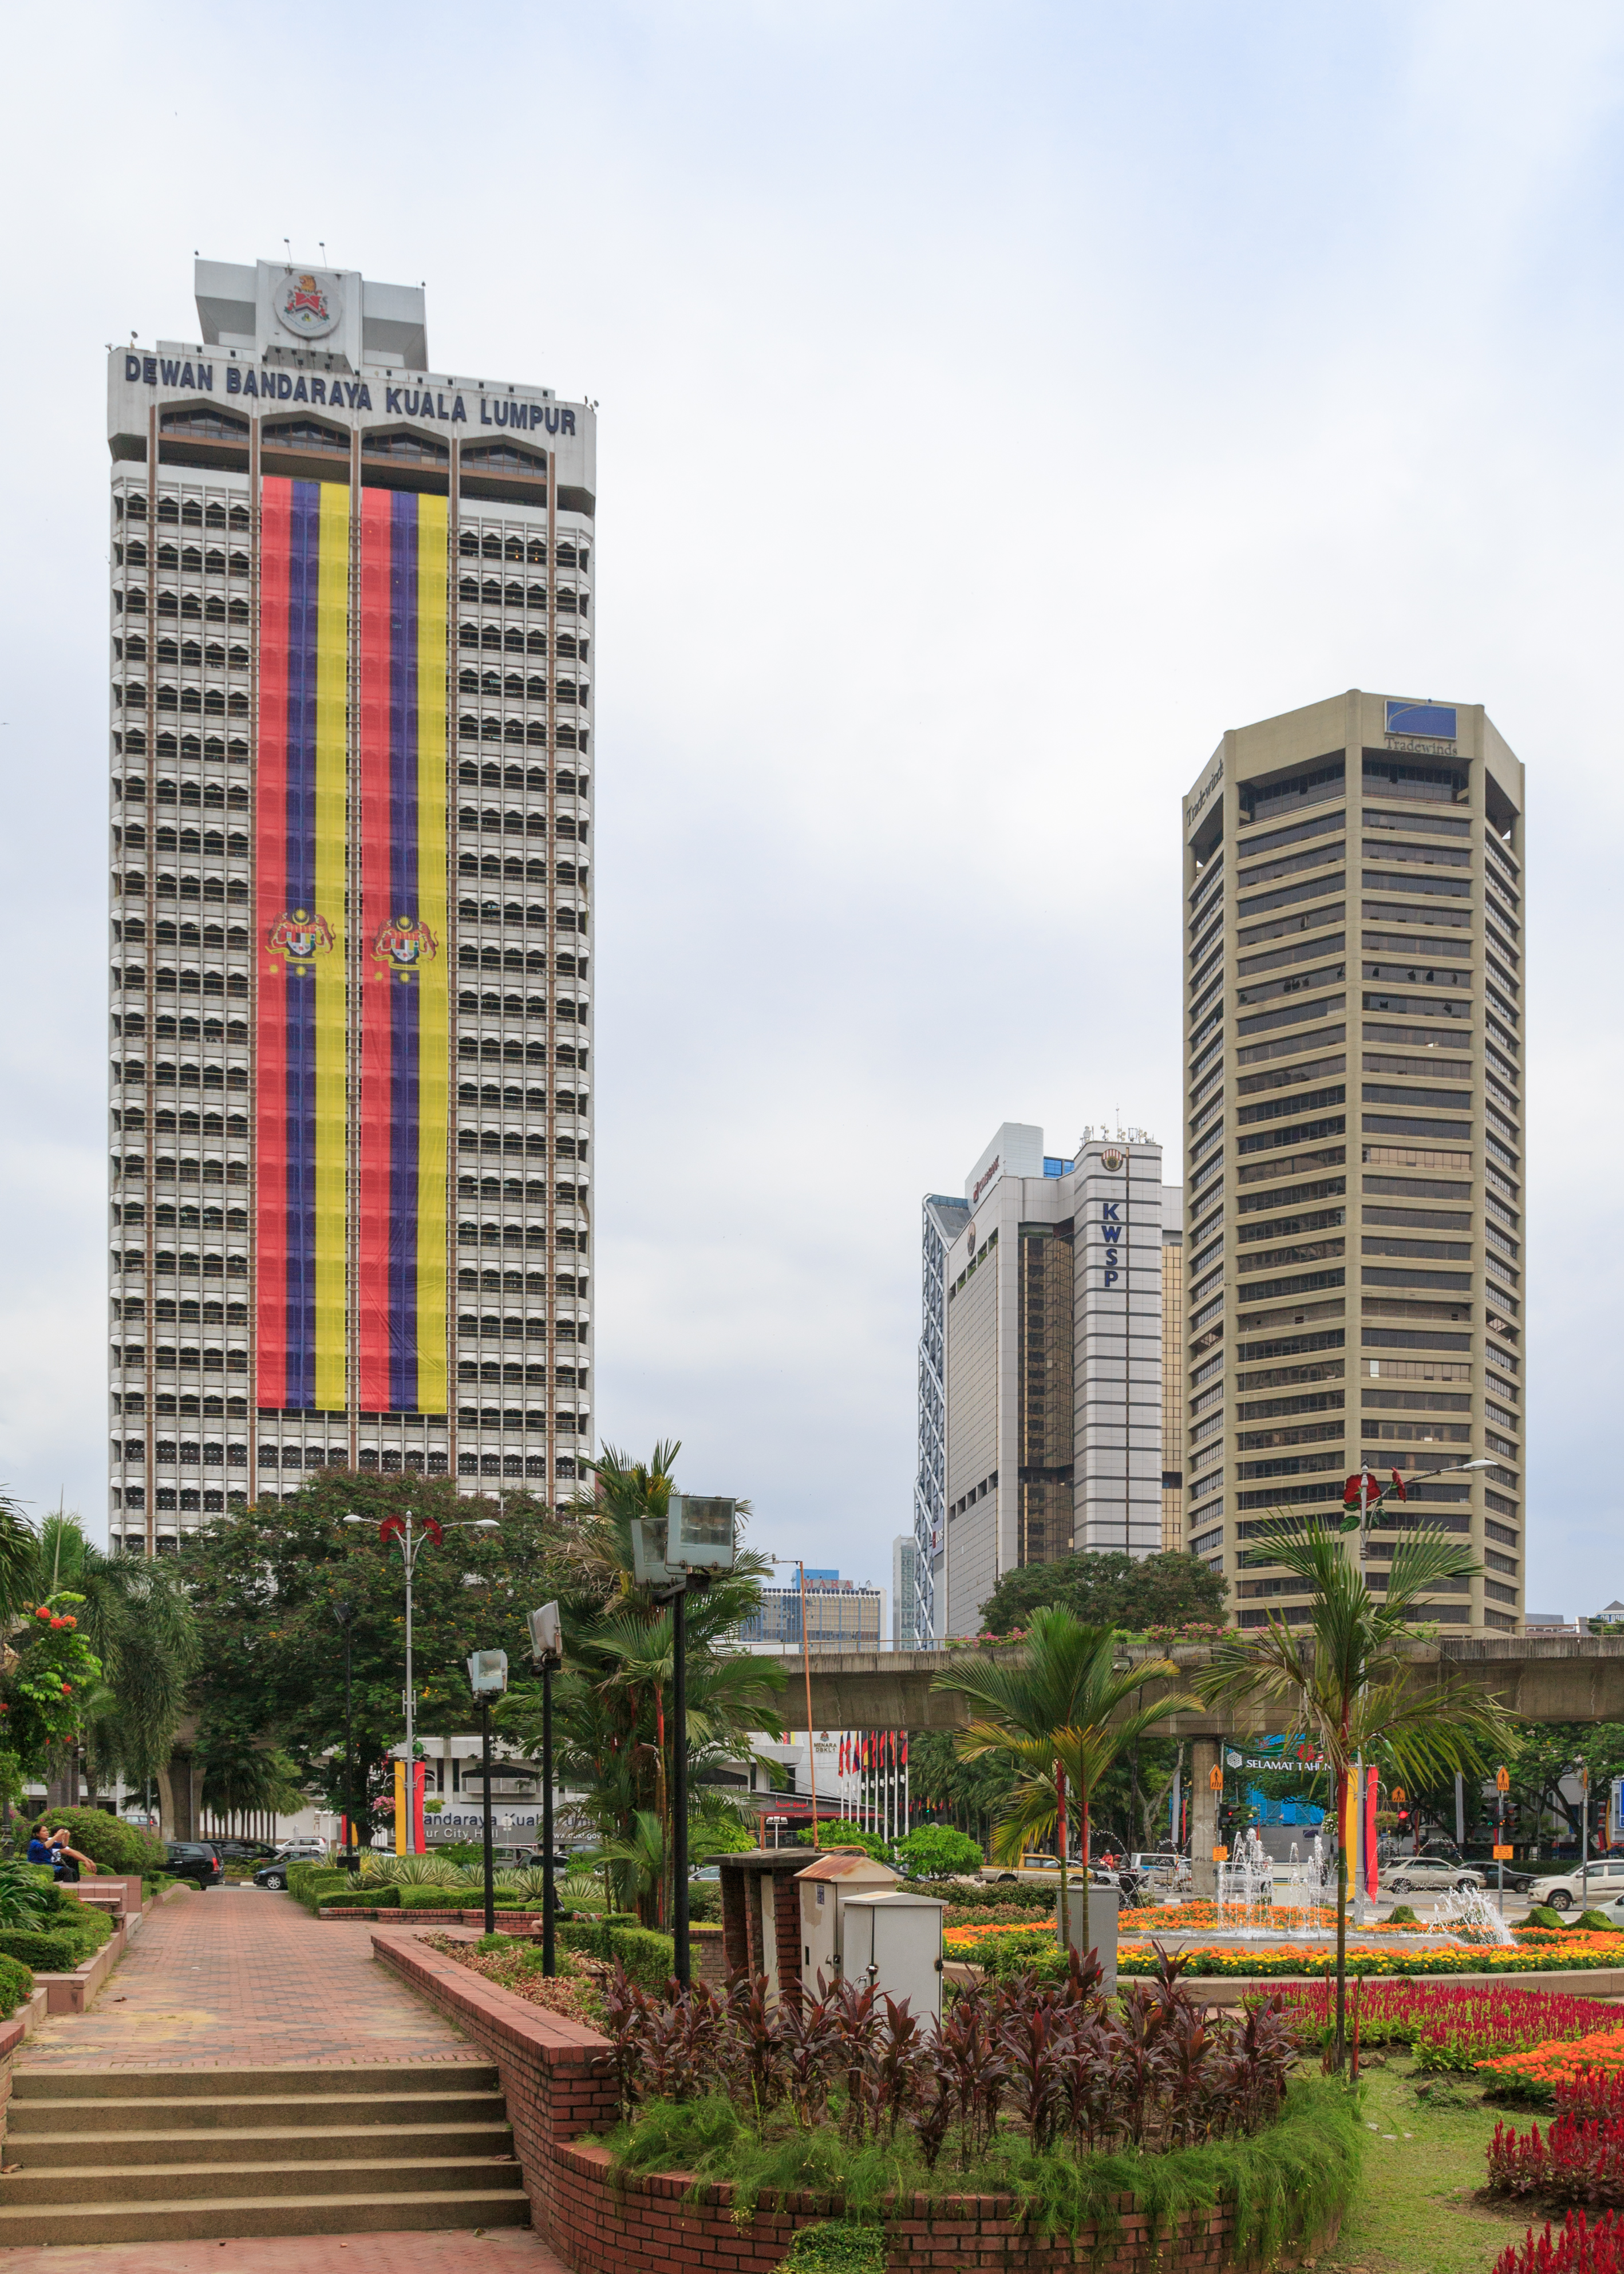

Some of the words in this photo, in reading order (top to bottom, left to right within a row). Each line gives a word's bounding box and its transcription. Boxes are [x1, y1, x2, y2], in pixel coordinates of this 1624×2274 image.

[125, 355, 212, 391] DEWAN
[227, 367, 372, 410] BANDARAYA
[386, 387, 467, 423] KUALA
[481, 398, 575, 436] LUMPUR
[1384, 736, 1457, 756] Tradewinds
[1186, 759, 1224, 827] Tradewinds
[1101, 1202, 1122, 1288] KWSP
[803, 1578, 853, 1589] MARA
[1246, 1759, 1294, 1771] SELAMAT
[423, 1813, 497, 1829] andaraya
[444, 1829, 468, 1839] City
[475, 1829, 498, 1838] Hll
